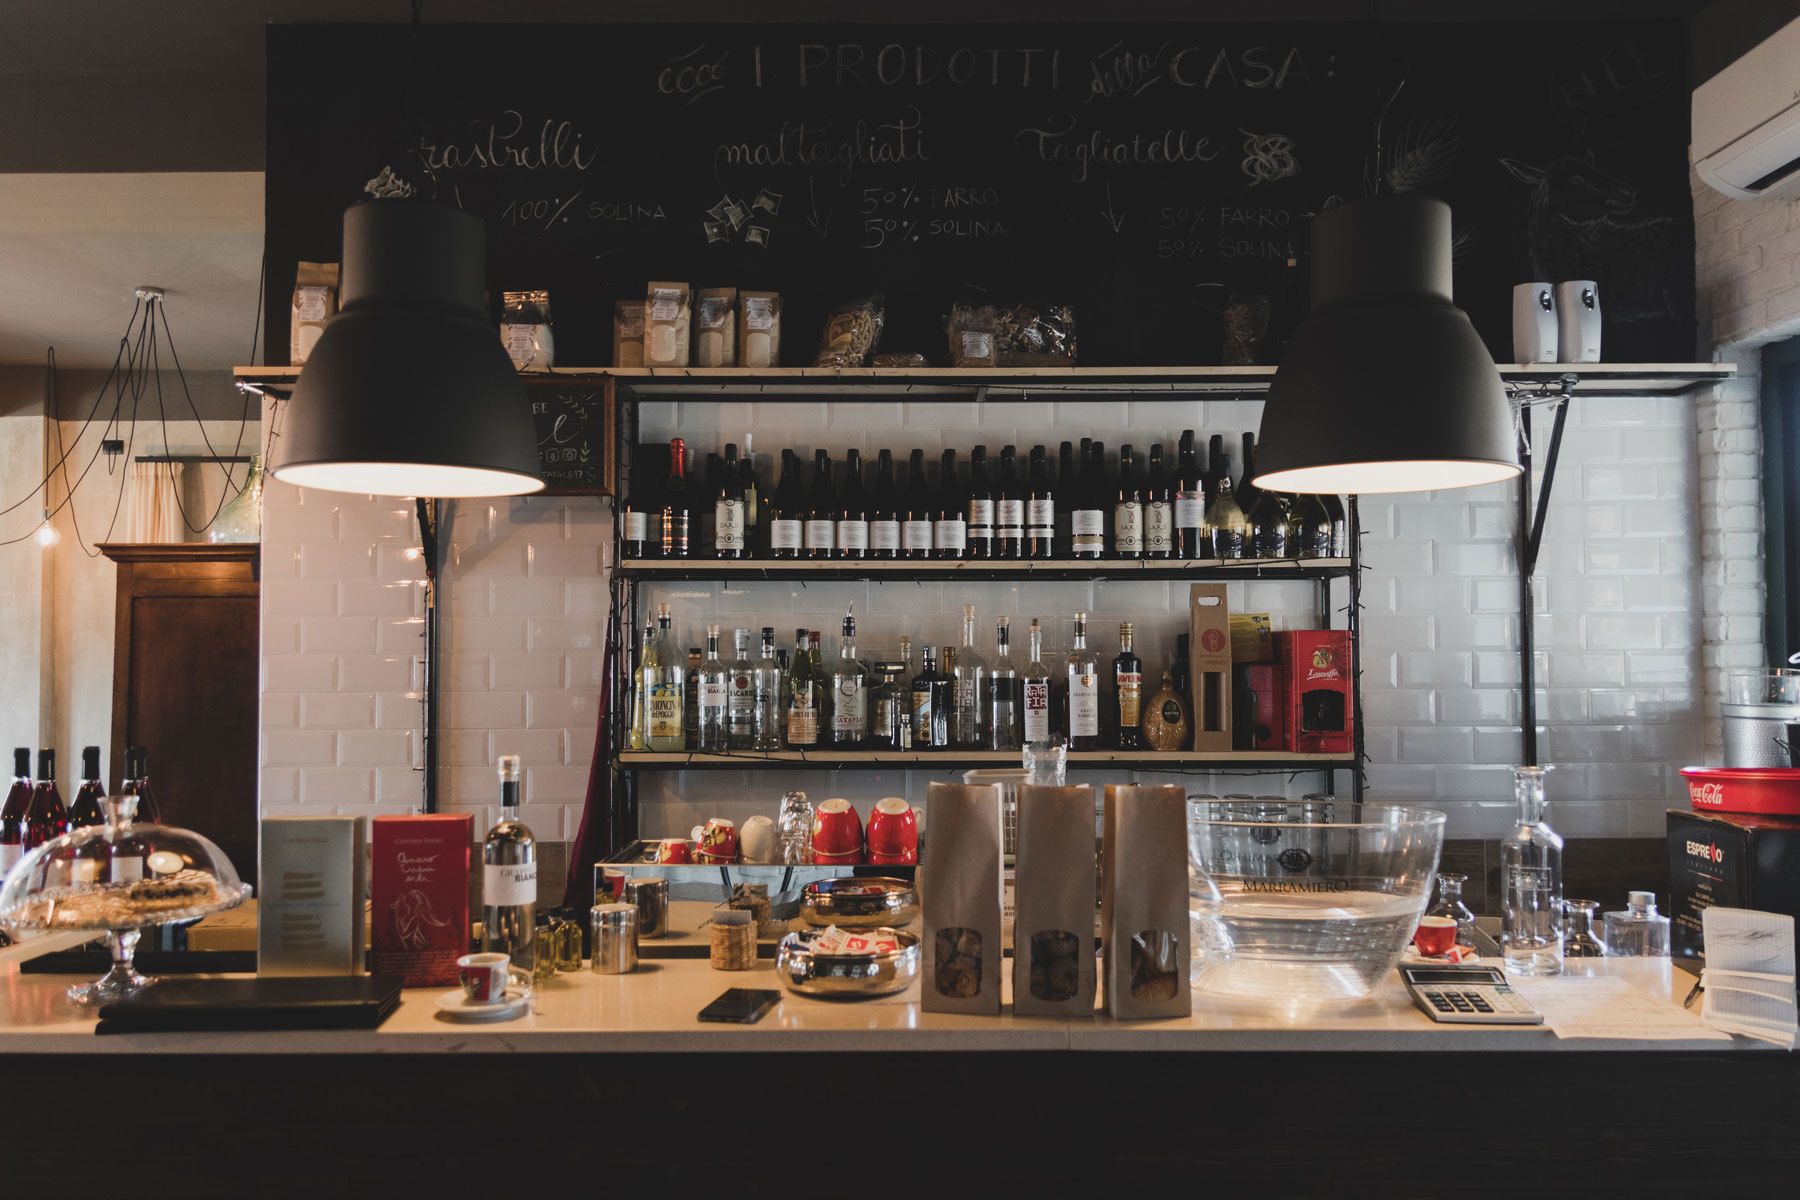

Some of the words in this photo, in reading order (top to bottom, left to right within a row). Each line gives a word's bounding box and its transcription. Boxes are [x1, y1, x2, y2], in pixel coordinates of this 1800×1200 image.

[657, 50, 728, 94] ecco
[752, 45, 763, 87] I
[800, 44, 1061, 88] PRODOTTI
[1083, 41, 1170, 103] della
[714, 105, 931, 186] maltagliati
[1015, 113, 1224, 184] Tagliatelle
[502, 190, 583, 230] 100%
[588, 201, 667, 222] SOLINA
[858, 183, 920, 214] 50%
[928, 187, 1000, 209] FARRO
[858, 217, 920, 248] 50%
[929, 218, 1009, 238] SOLINA
[1158, 205, 1206, 234] 50%
[1220, 207, 1290, 227] FARRO
[1157, 238, 1206, 258] 50%
[1218, 239, 1297, 259] SOLINA
[542, 470, 584, 480] TATALE17
[1241, 878, 1349, 893] MARRAMIERO
